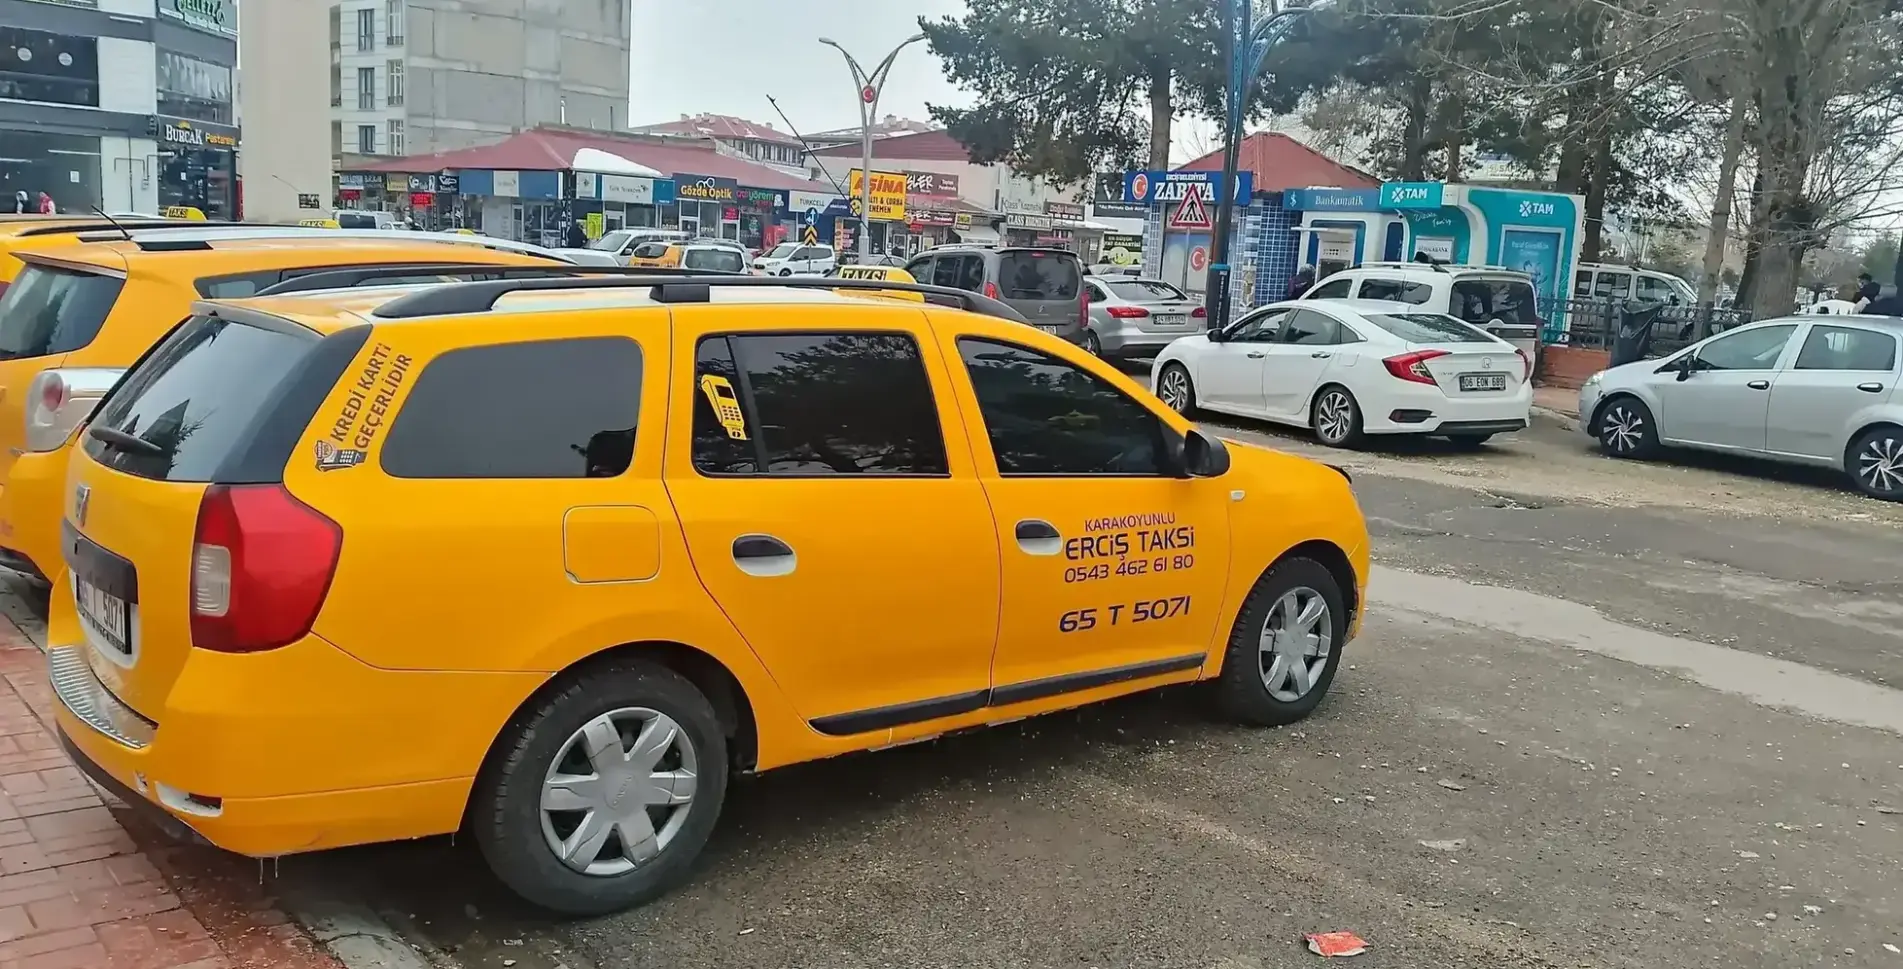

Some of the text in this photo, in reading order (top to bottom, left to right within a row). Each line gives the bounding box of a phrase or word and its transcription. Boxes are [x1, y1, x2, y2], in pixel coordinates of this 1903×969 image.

[681, 185, 732, 200] Gözde Optik
[1315, 195, 1364, 206] Bankamatik
[1405, 188, 1428, 199] TAM
[869, 205, 892, 214] ENEMEN
[1533, 203, 1554, 214] TAM
[354, 354, 413, 449] GEÇERLİDİR
[330, 388, 366, 442] KREDİ
[1085, 512, 1176, 532] KARAKOYUNLU
[1064, 554, 1194, 583] 0543 462 61 80
[1059, 595, 1191, 633] 65 T 5071
